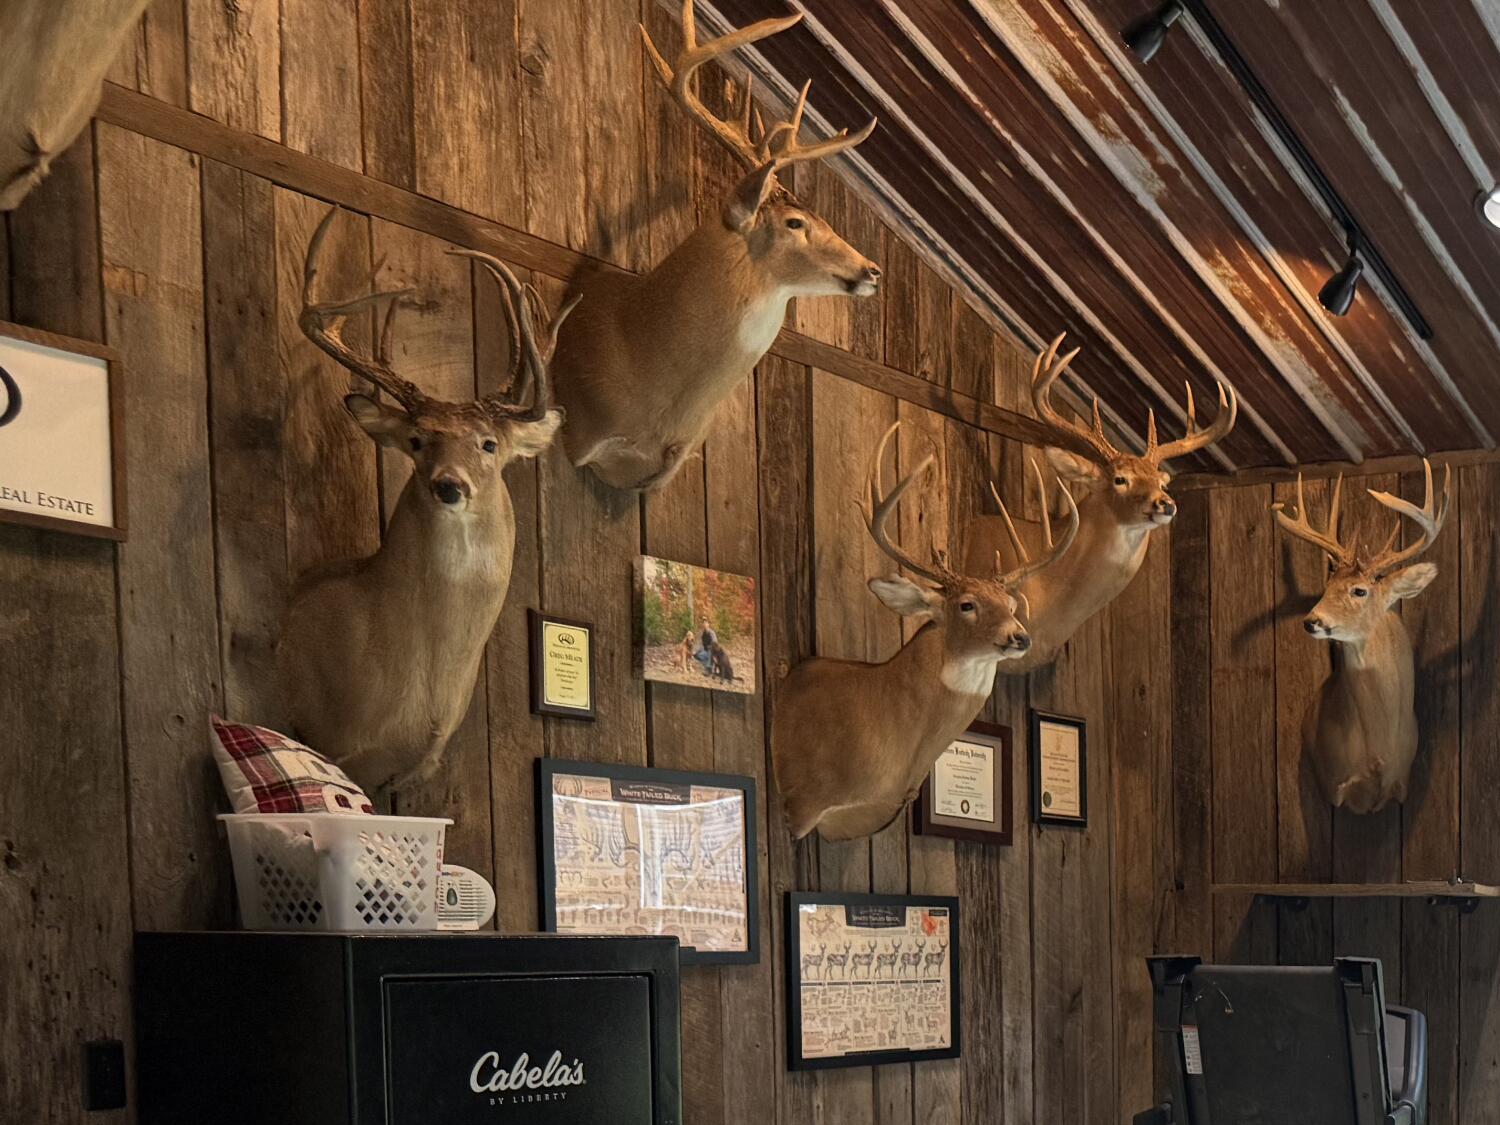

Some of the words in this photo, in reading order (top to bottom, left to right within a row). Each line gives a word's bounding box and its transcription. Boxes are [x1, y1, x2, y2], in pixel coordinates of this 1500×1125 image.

[37, 491, 95, 516] ESTATE
[469, 1049, 584, 1093] Cabela's
[489, 1096, 505, 1106] BY
[513, 1092, 568, 1104] LIBERTY
